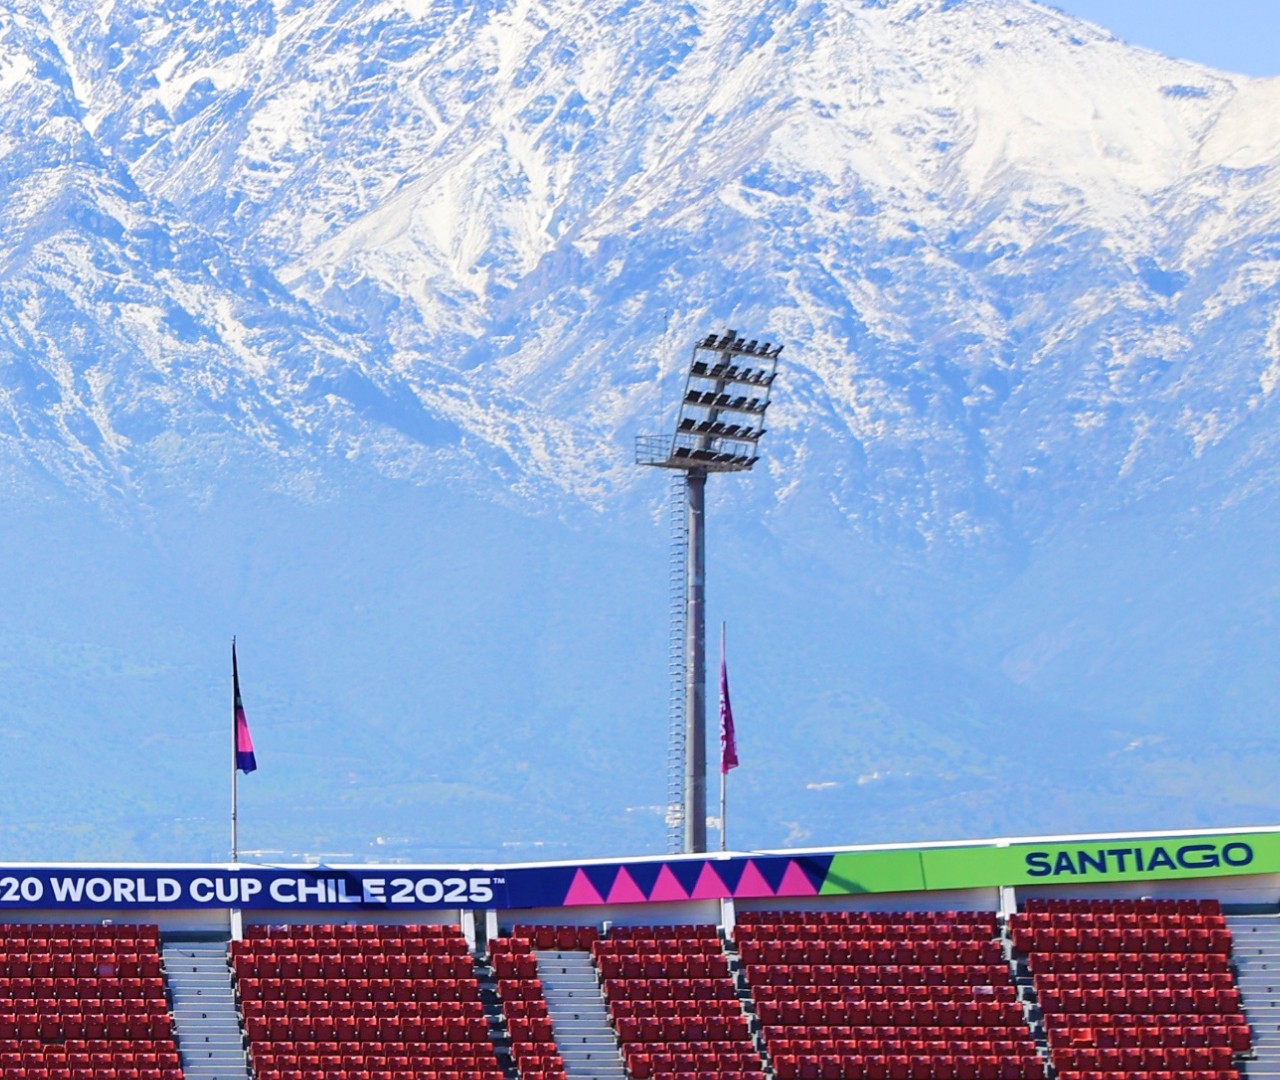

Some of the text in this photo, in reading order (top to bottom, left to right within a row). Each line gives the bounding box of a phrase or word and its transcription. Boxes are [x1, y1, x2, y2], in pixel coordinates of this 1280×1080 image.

[1025, 843, 1254, 877] SANTIAGO
[50, 878, 181, 902] WORLD
[190, 878, 262, 902] CUP
[270, 879, 386, 902] CHILE
